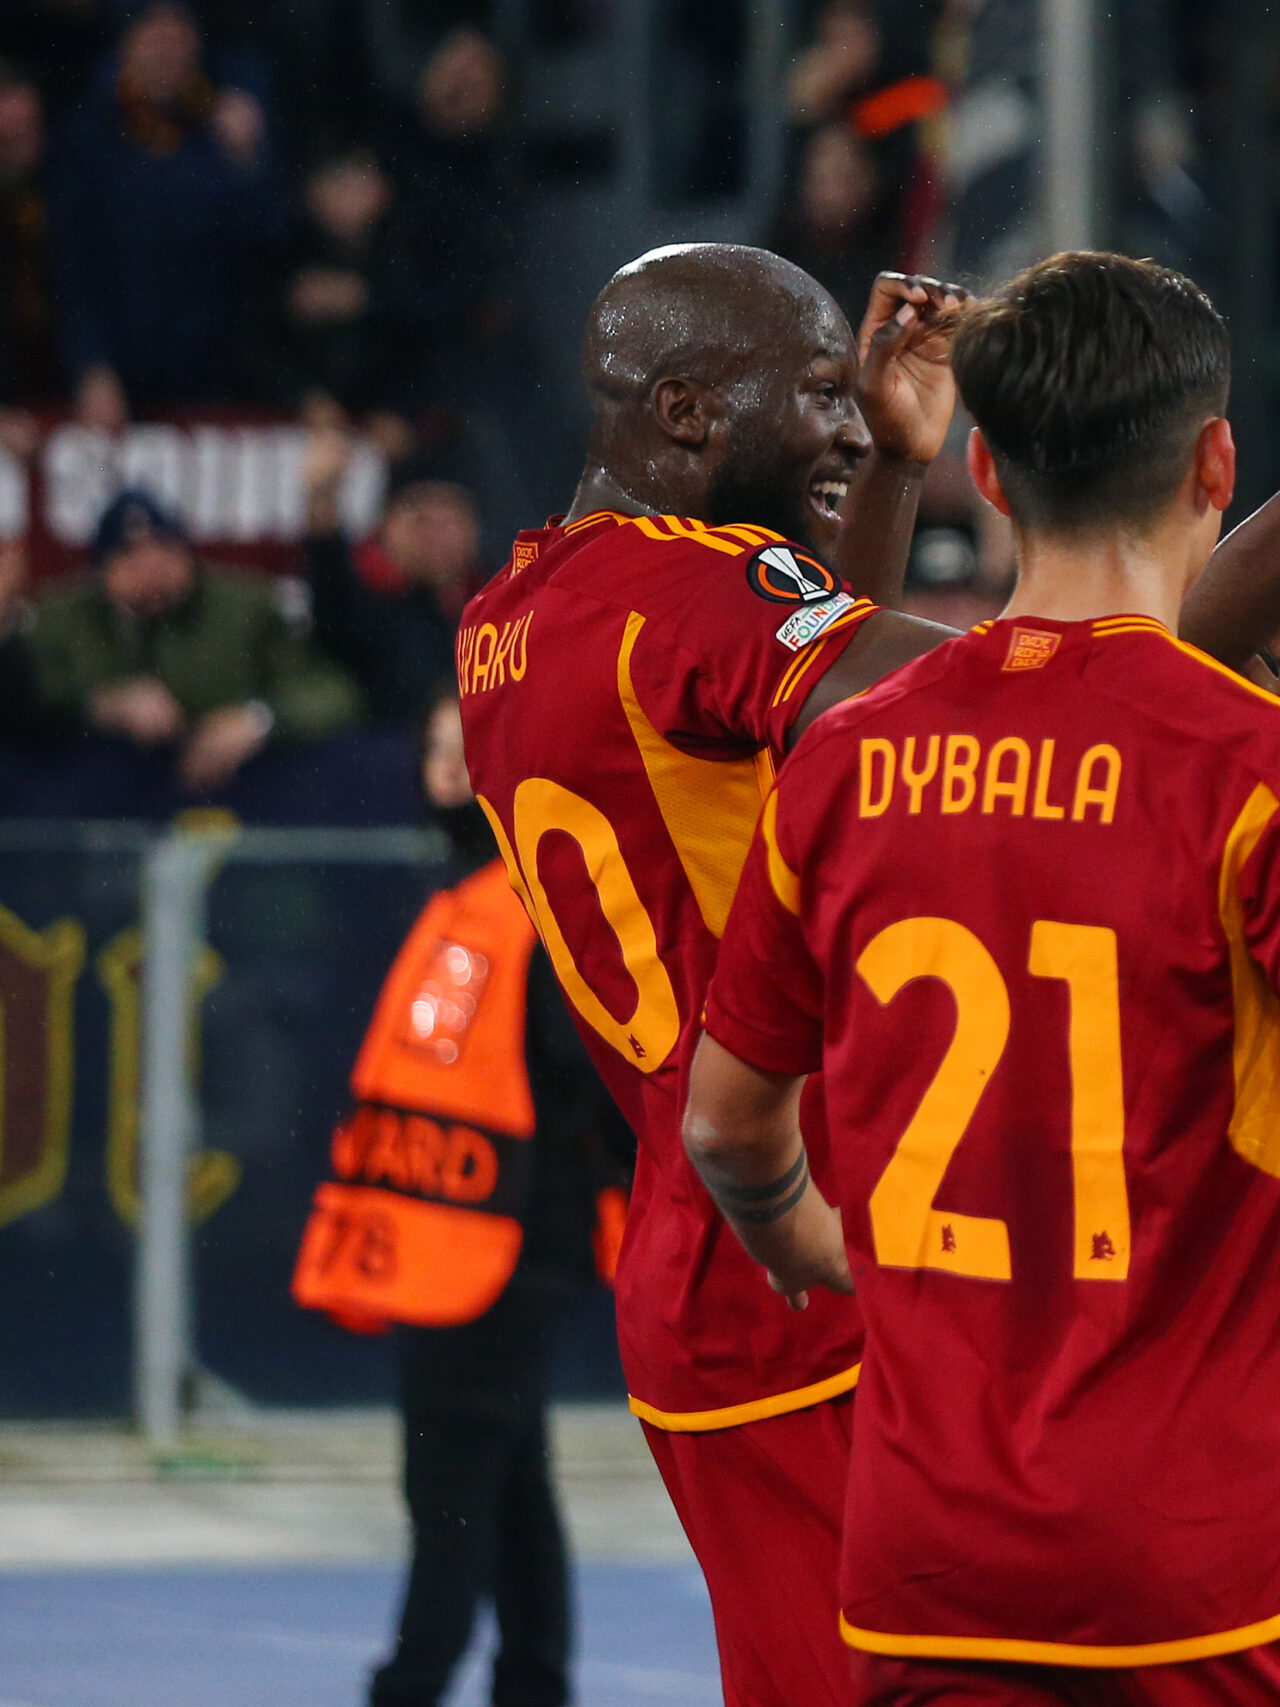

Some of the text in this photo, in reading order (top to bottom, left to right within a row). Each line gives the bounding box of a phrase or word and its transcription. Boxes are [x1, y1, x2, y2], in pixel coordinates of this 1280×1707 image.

[458, 610, 534, 699] UKAKU
[788, 594, 846, 646] FOUNDA
[858, 734, 1122, 824] DYBALA
[475, 777, 680, 1073] 0
[856, 916, 1131, 1280] 21
